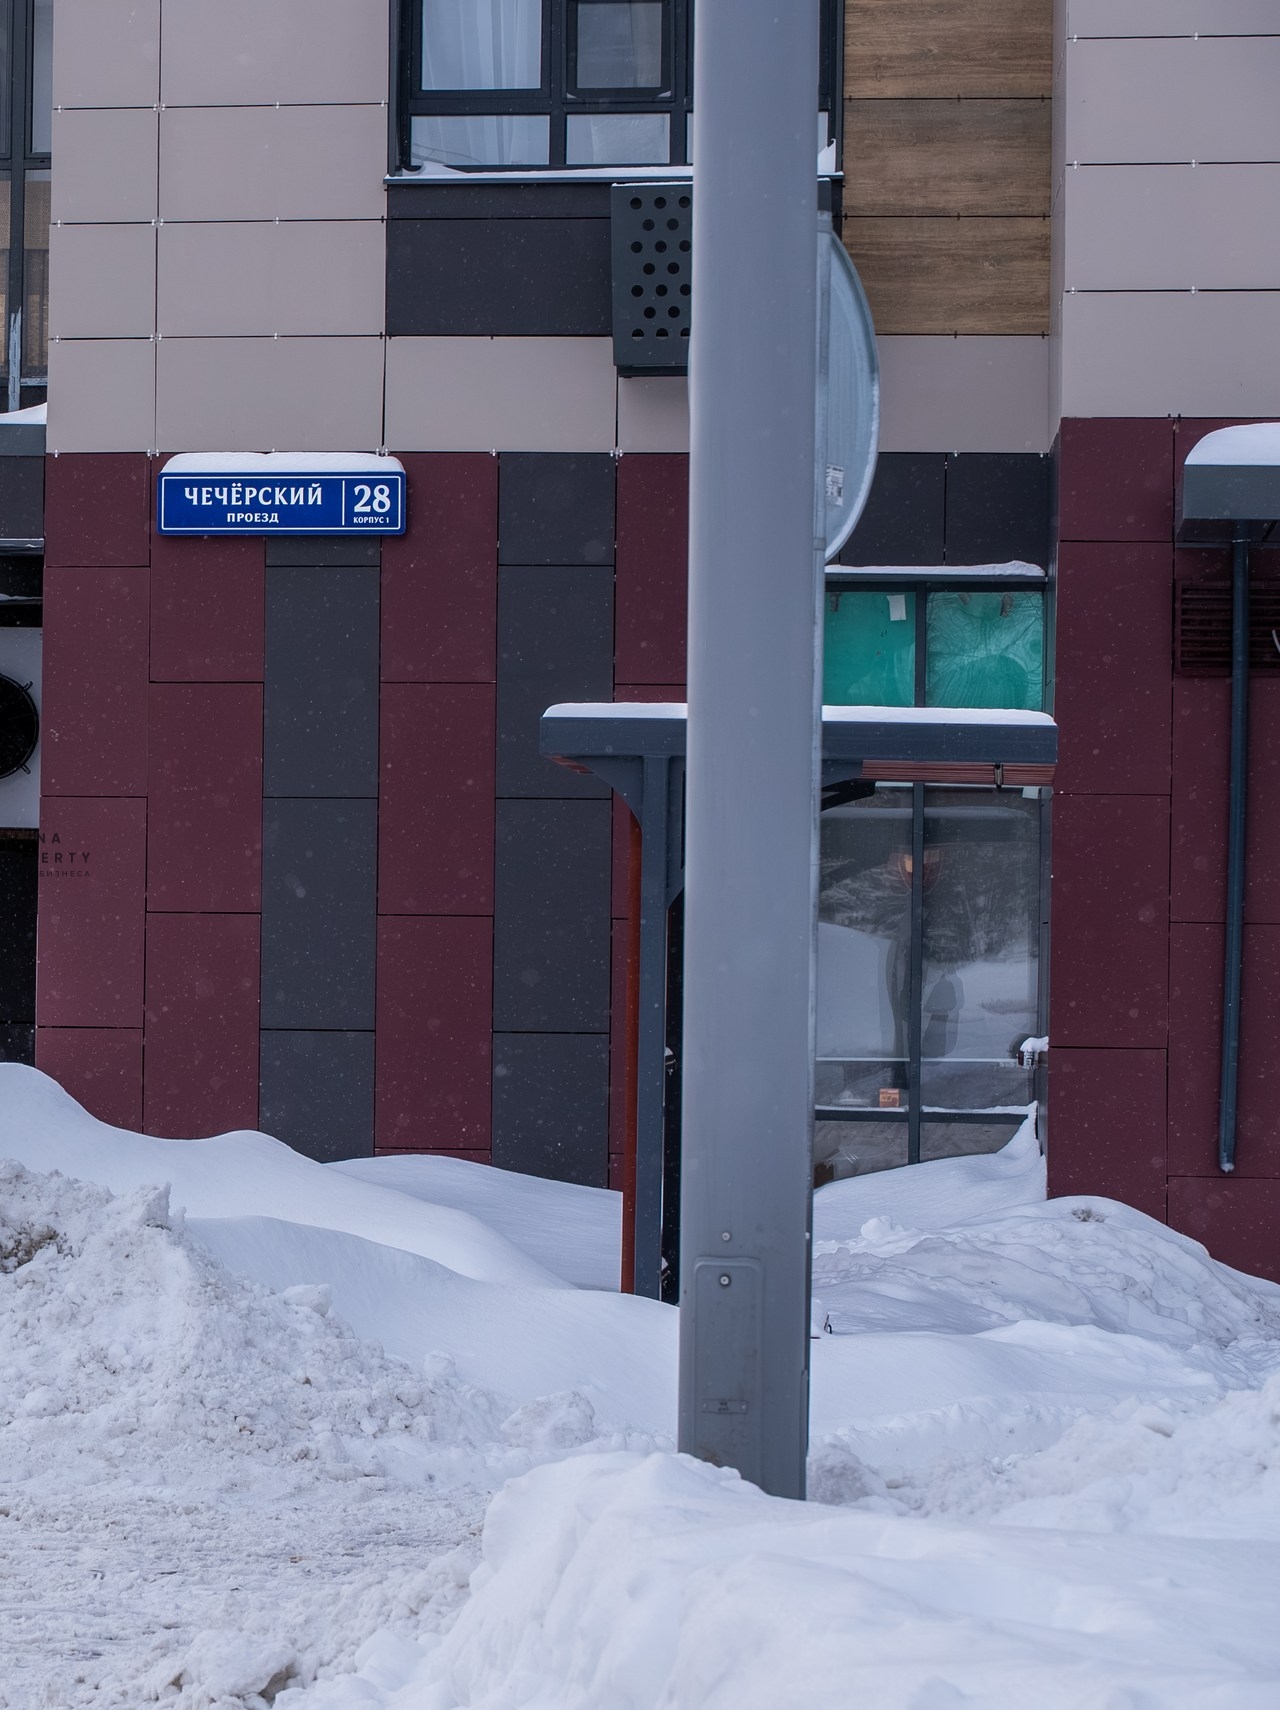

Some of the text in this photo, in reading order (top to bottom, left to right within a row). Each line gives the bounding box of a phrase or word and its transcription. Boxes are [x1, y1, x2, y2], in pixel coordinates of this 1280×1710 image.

[184, 482, 323, 506] ЧЕЧЁРСКИЙ
[353, 484, 391, 513] 28
[227, 512, 279, 524] ПРОЕЗД
[353, 516, 390, 524] КОРПУС 1
